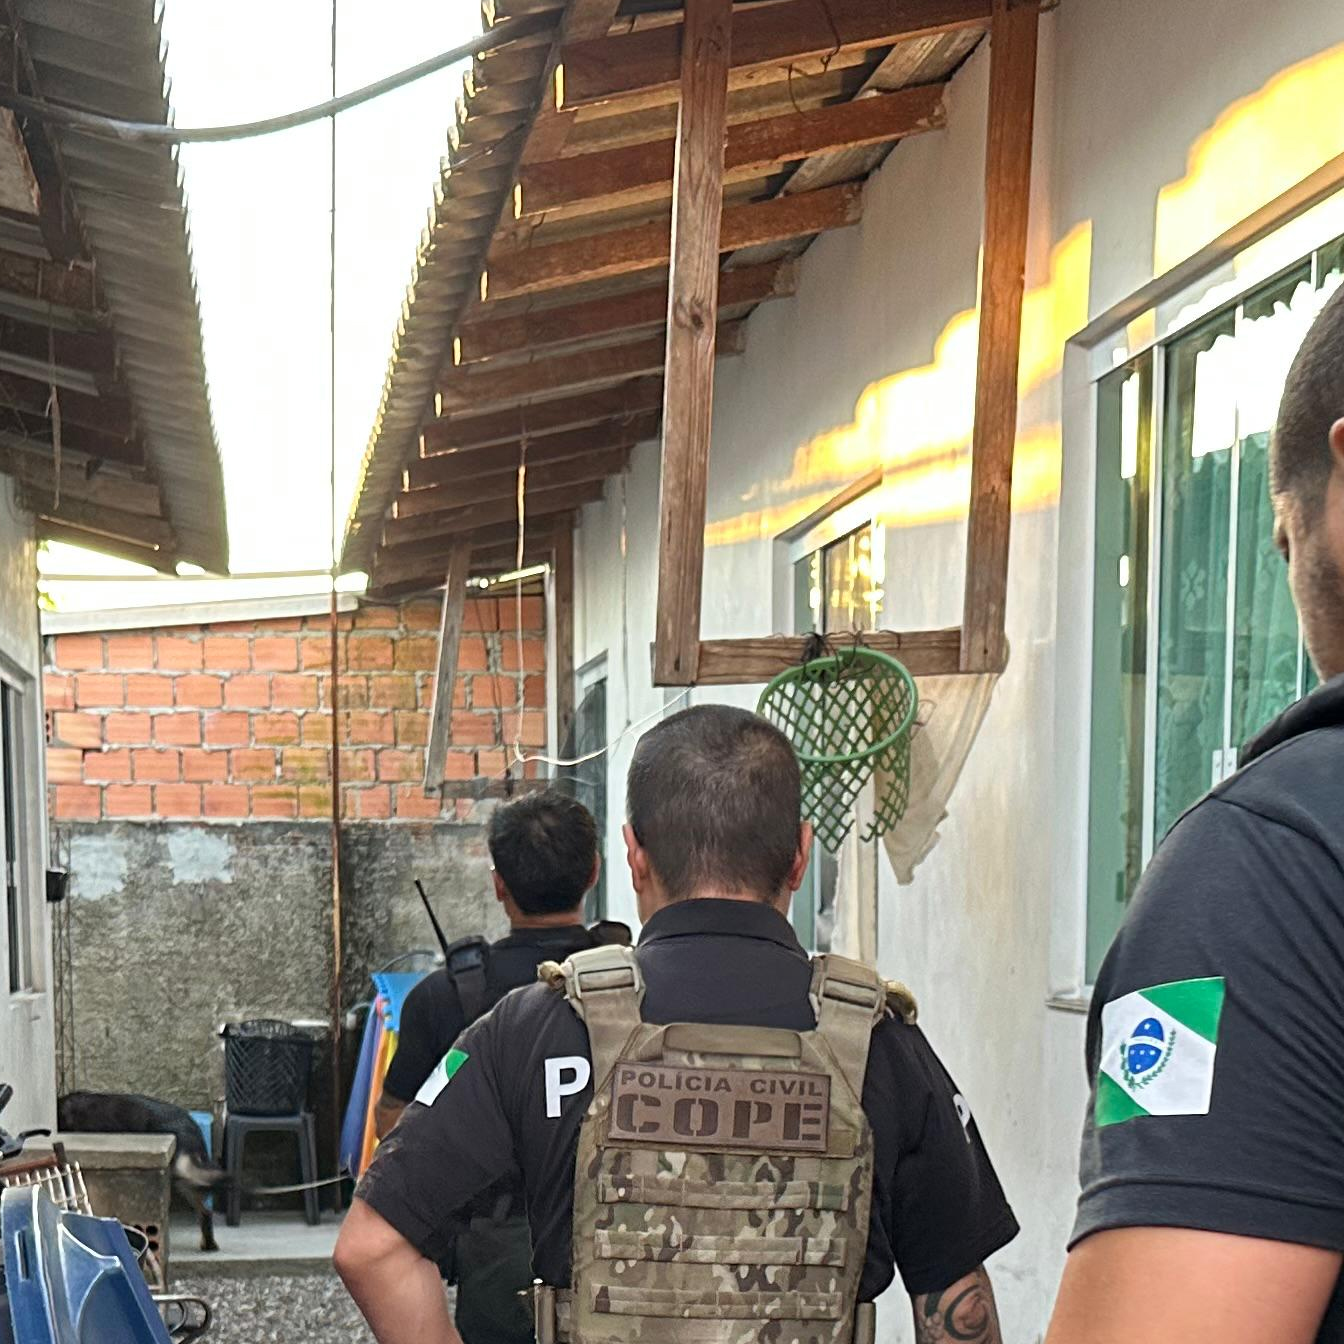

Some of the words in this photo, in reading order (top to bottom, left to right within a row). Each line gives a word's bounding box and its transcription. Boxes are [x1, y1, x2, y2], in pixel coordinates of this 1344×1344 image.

[620, 1068, 732, 1093] POLÍCIA
[750, 1078, 824, 1097] CIVIL
[616, 1093, 822, 1142] COPE
